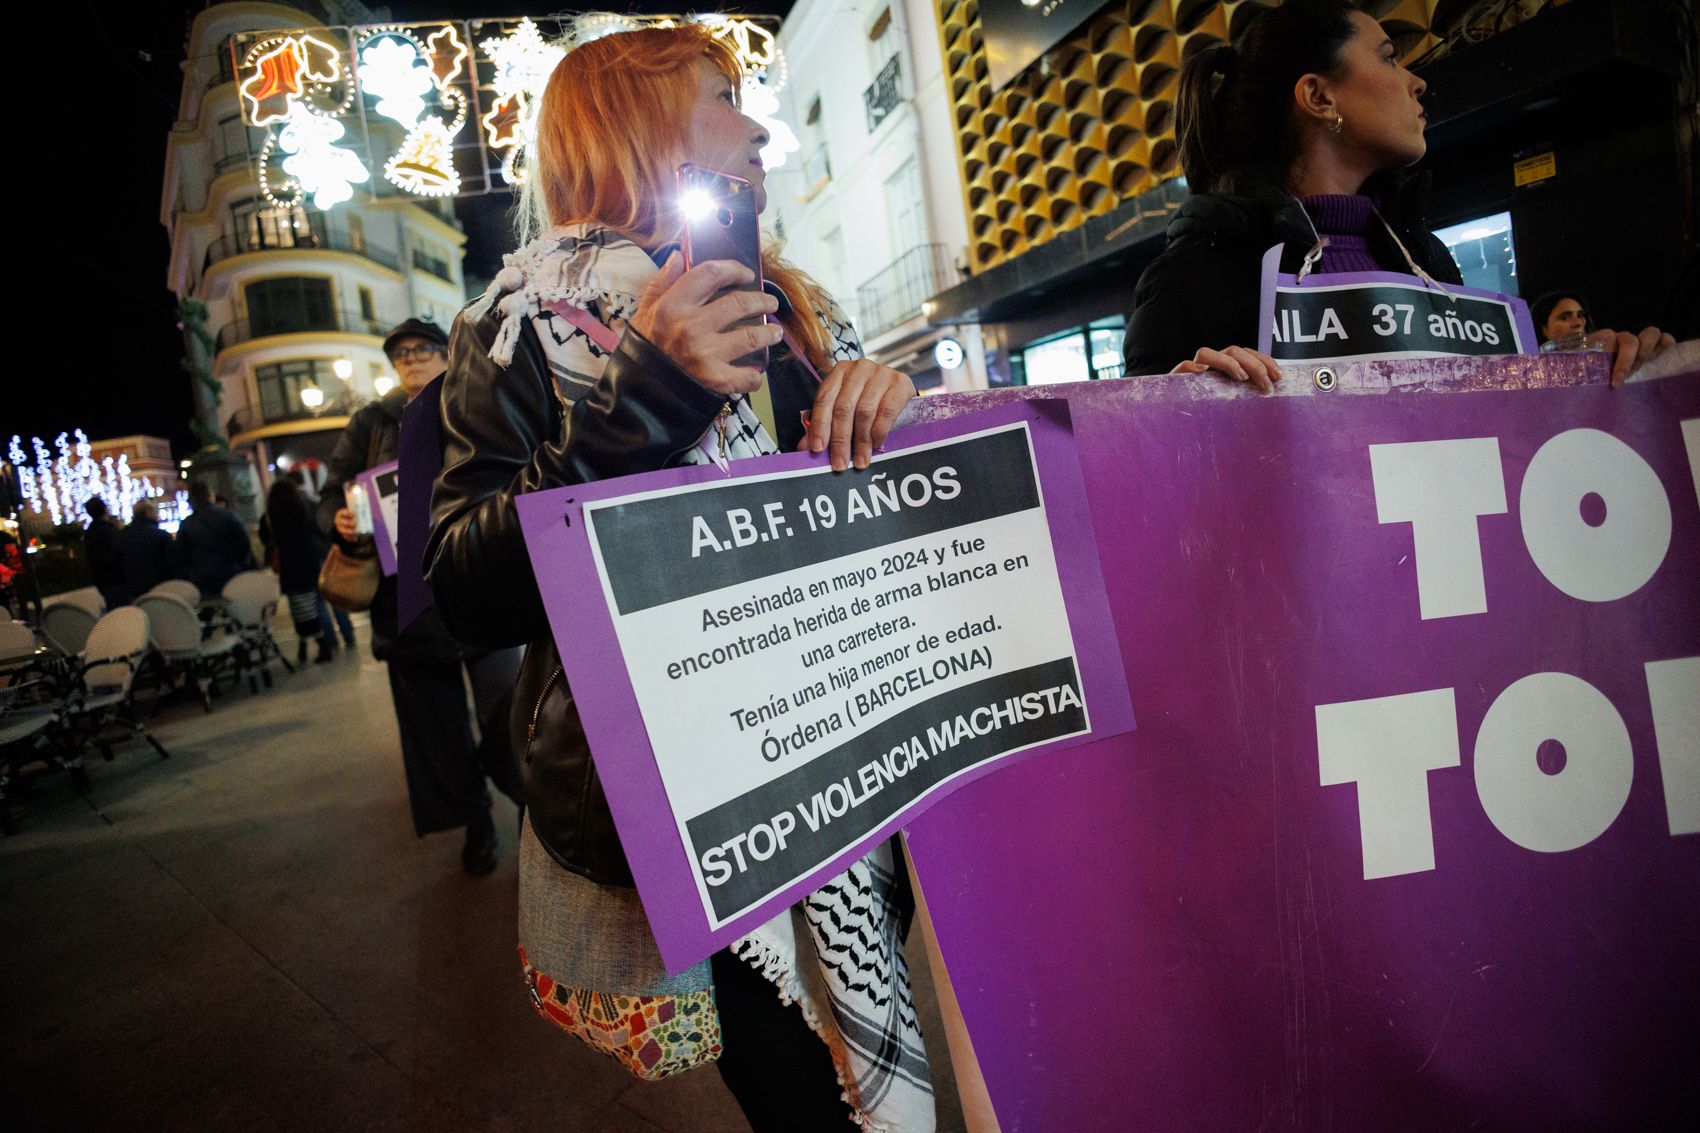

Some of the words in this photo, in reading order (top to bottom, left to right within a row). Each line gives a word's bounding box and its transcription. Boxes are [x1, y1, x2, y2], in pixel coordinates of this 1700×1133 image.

[1372, 303, 1415, 336] 37
[1427, 311, 1500, 345] años
[691, 502, 794, 558] A.B.F.
[799, 494, 837, 532] 19
[847, 466, 962, 523] AÑOS
[1368, 417, 1700, 620] TO
[666, 624, 791, 680] encontrada
[793, 605, 848, 637] herida
[850, 597, 871, 616] de
[874, 582, 923, 608] arma
[927, 562, 998, 592] blanca
[1003, 554, 1029, 572] en
[702, 585, 805, 632] Asesinada
[808, 580, 830, 598] en
[832, 566, 877, 592] mayo
[881, 548, 929, 576] 2024
[933, 547, 945, 565] y
[950, 537, 985, 557] fue
[801, 643, 835, 668] una
[838, 615, 916, 654] carretera.
[730, 694, 790, 732] Tenía
[792, 681, 827, 707] una
[828, 666, 859, 691] hija
[861, 643, 911, 678] menor
[916, 634, 940, 654] de
[945, 615, 1002, 644] edad.
[761, 711, 843, 763] Órdena
[854, 646, 993, 718] BARCELONA)
[700, 811, 796, 887] STOP
[795, 736, 930, 833] VIOLENCIA
[926, 683, 1083, 756] MACHISTA
